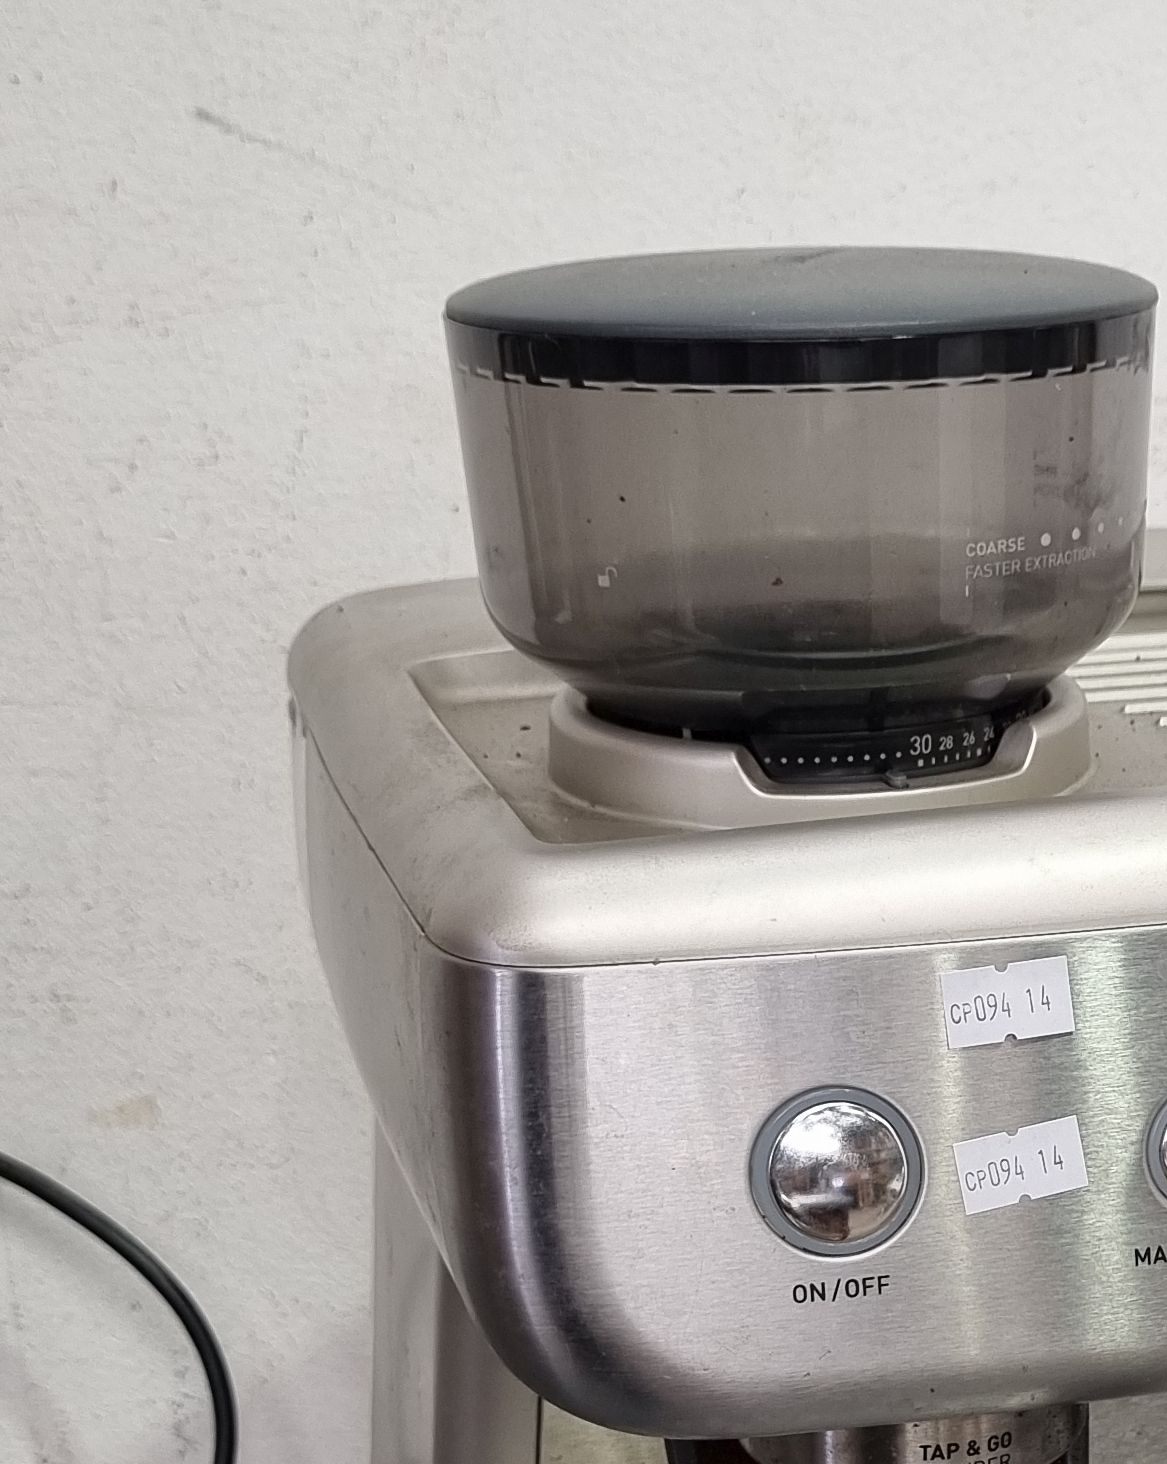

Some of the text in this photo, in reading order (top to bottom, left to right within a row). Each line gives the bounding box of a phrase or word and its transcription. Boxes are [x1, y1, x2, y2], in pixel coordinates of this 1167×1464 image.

[965, 536, 1026, 557] COARSE
[965, 546, 1097, 579] FASTER EXTRACTION
[909, 734, 932, 756] 30
[938, 735, 954, 750] 28
[962, 732, 976, 746] 26
[950, 985, 1051, 1025] CP094 14
[965, 1145, 1064, 1192] CP094 14
[918, 1431, 1013, 1461] TAP & GO
